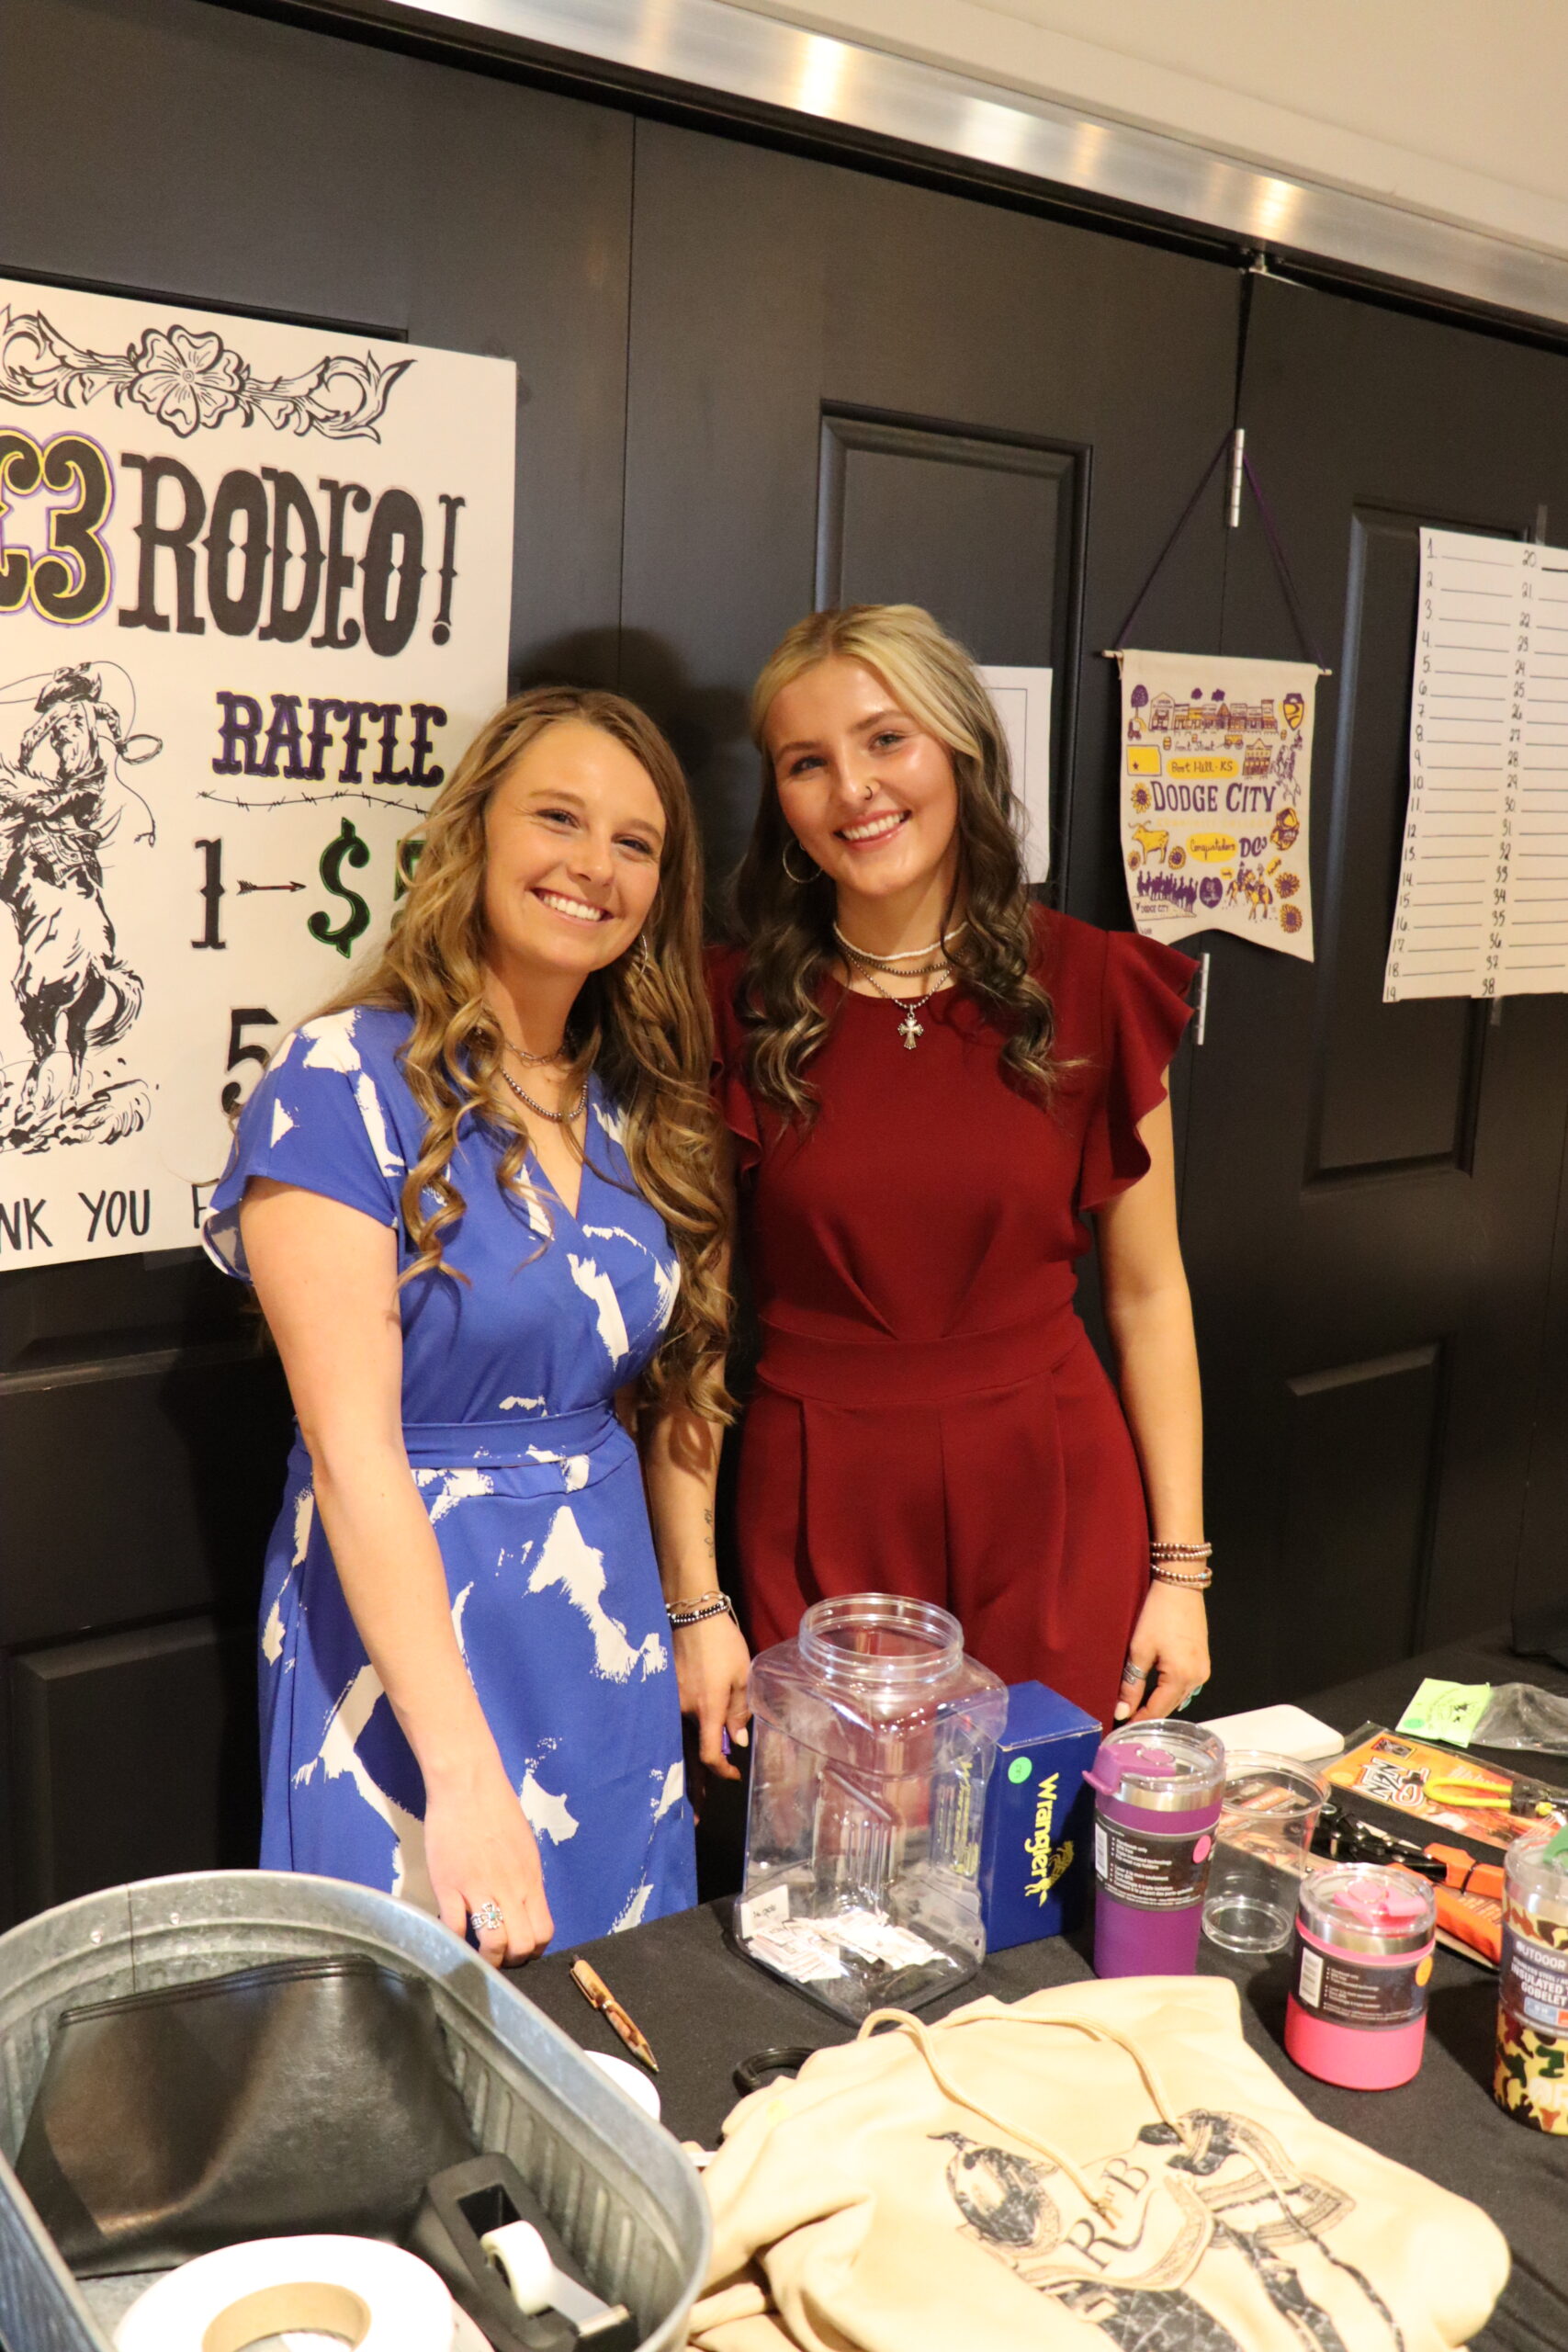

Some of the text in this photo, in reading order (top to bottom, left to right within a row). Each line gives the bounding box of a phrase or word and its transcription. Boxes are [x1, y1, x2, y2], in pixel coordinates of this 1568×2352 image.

[118, 452, 467, 658] RODEO!
[212, 691, 448, 789] RAFFLE
[1194, 759, 1214, 774] Hill
[1150, 781, 1277, 813] DODGE CITY
[191, 838, 227, 950] 1
[78, 1189, 150, 1243] YOU
[1023, 1771, 1060, 1877] Wrangler
